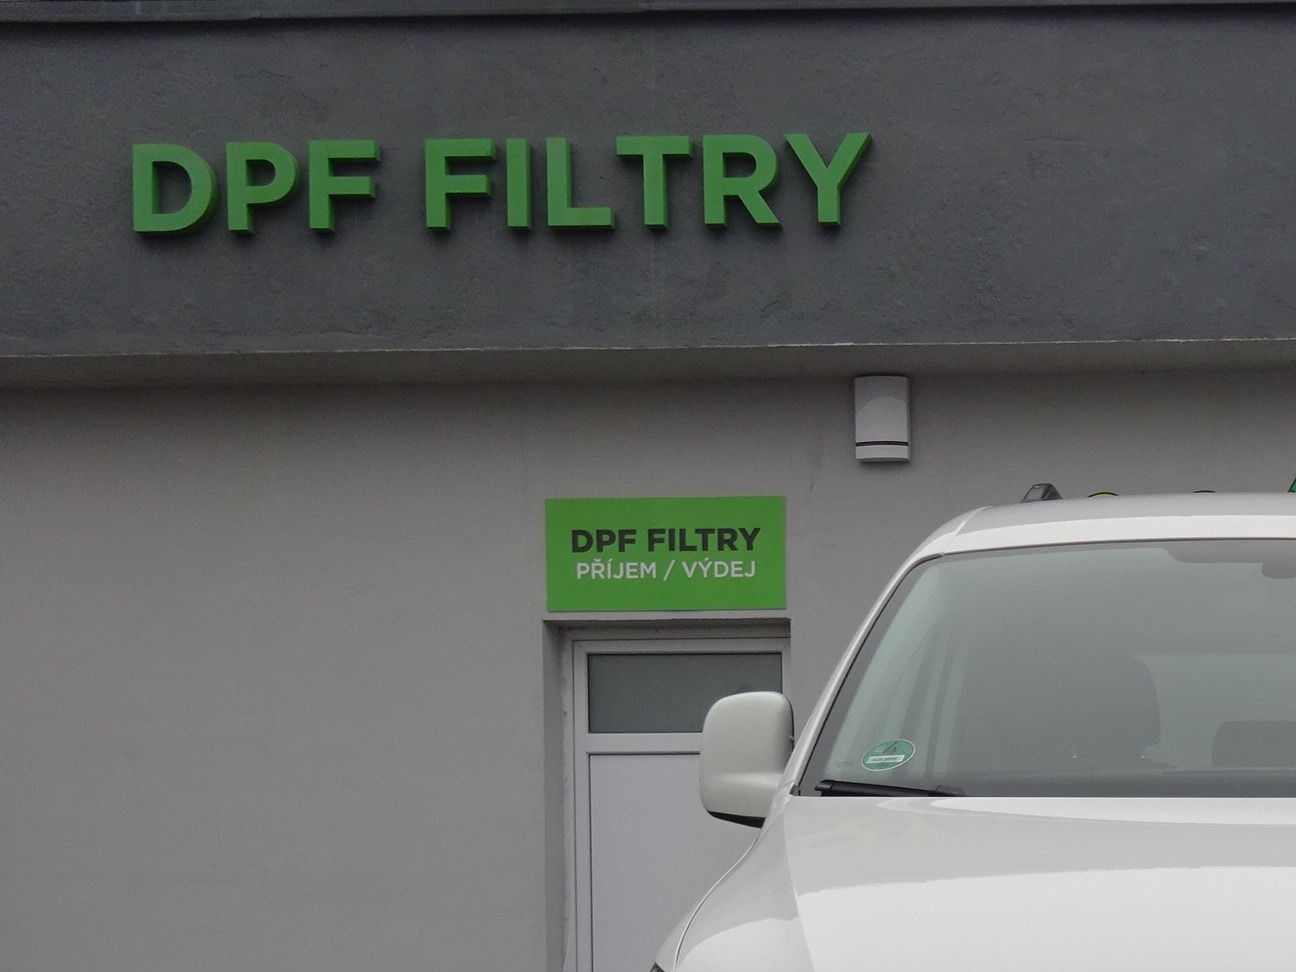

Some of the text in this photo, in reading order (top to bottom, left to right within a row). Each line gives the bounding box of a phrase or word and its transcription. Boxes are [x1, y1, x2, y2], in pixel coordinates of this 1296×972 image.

[132, 133, 872, 235] DPF FILTRY
[571, 527, 761, 553] DPF FILTRY
[576, 557, 756, 581] PŘÍJEM / VÝDEJ
